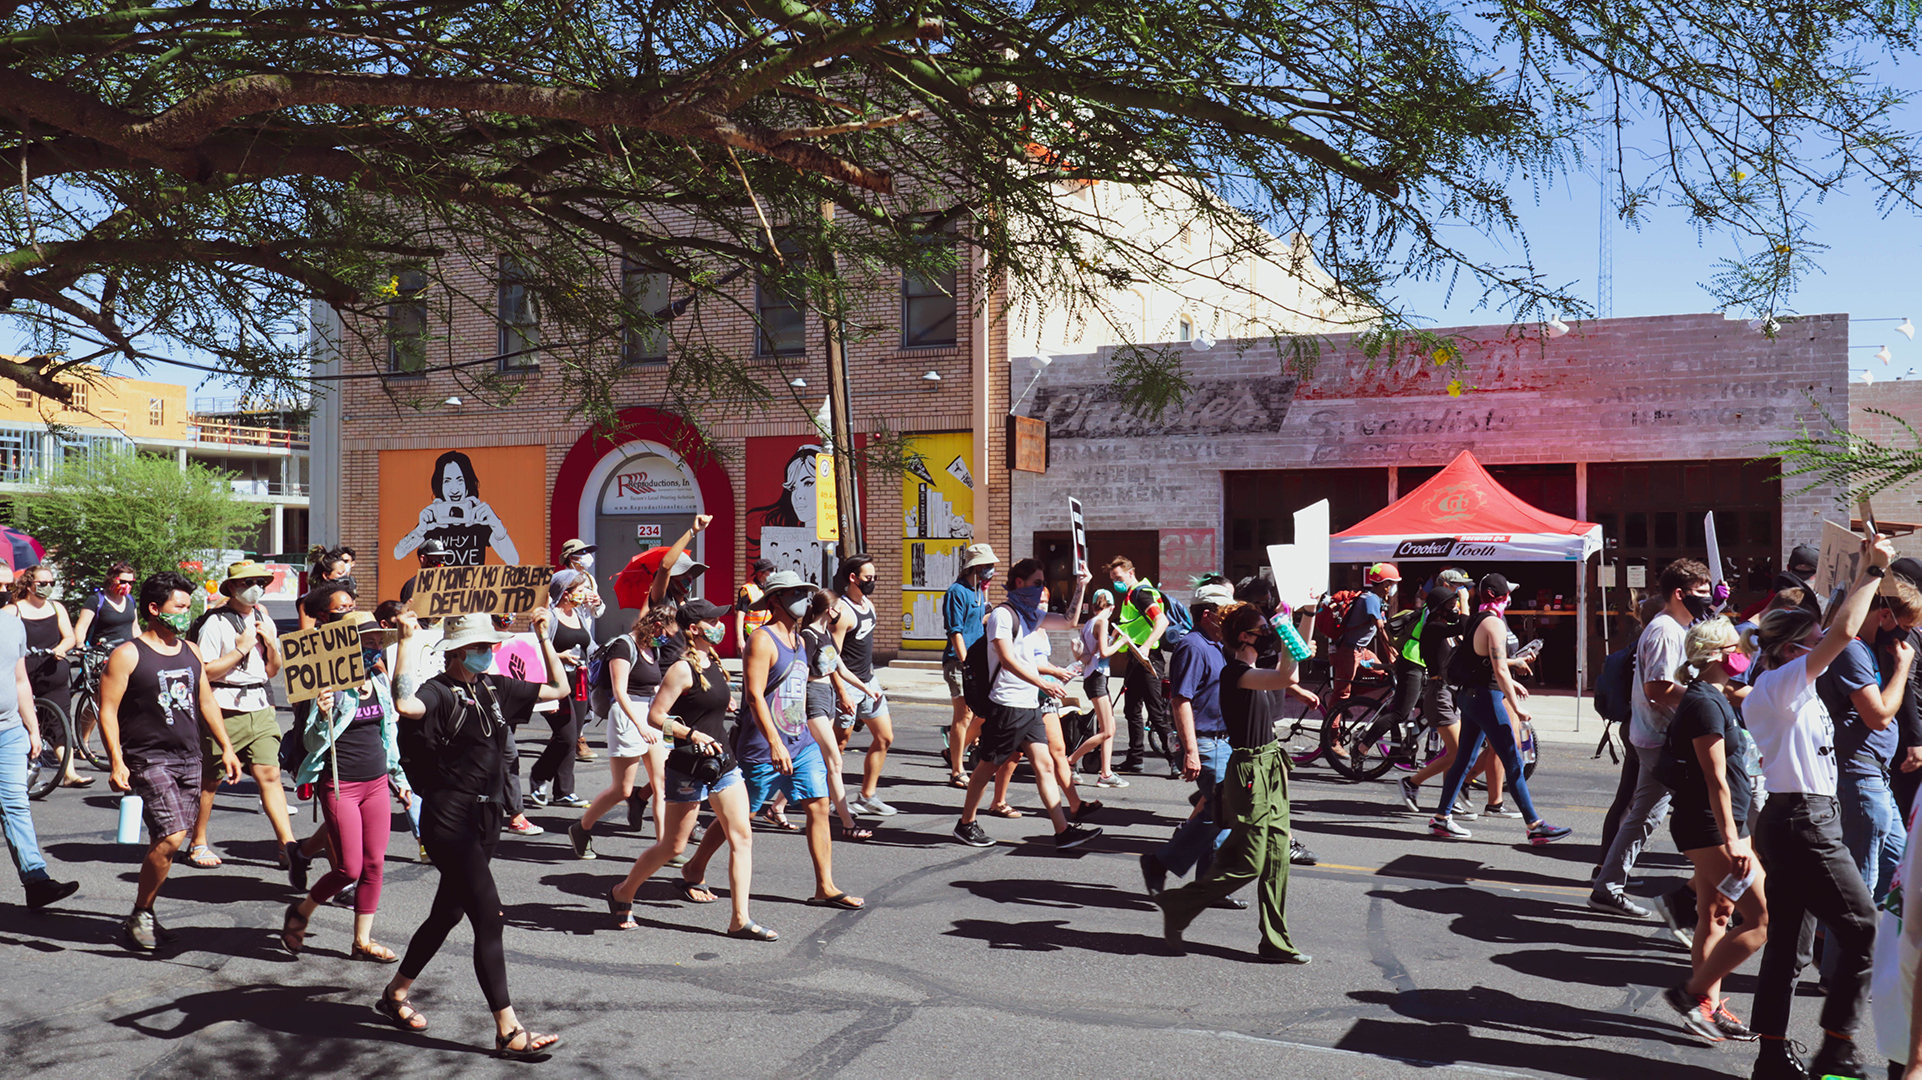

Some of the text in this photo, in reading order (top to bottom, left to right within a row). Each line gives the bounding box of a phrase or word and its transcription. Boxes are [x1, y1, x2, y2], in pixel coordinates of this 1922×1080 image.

[628, 479, 681, 489] Reproductions,
[439, 534, 478, 548] WHY I
[639, 526, 660, 536] 234
[443, 549, 480, 566] OVE
[1160, 534, 1213, 568] GM
[1399, 541, 1496, 557] Crooked Tooth
[501, 565, 555, 588] PROBLEMS
[429, 586, 537, 617] DEFUND TPD
[282, 625, 360, 661] DEFUND
[285, 651, 364, 695] POLICE
